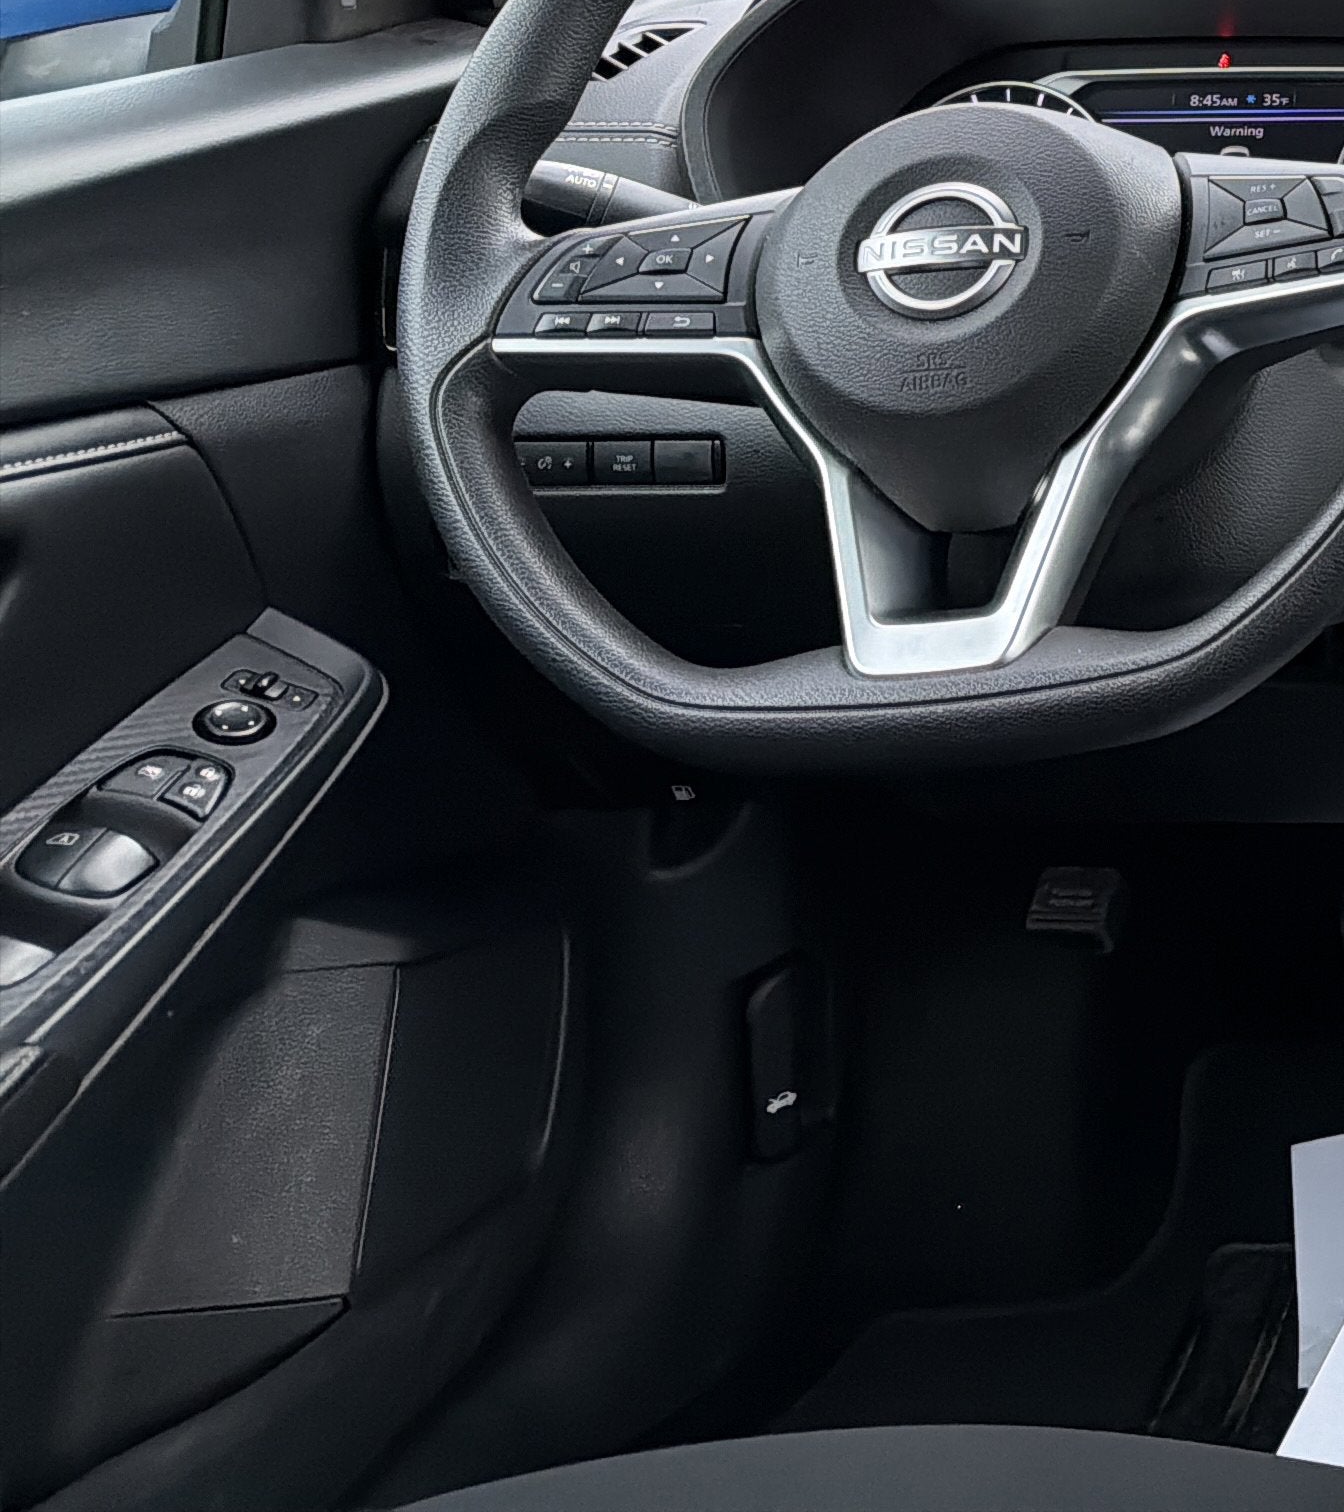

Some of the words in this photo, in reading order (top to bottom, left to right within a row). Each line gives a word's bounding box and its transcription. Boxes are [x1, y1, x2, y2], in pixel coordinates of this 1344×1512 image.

[1210, 125, 1264, 139] Warning
[565, 174, 597, 188] AUTO
[1247, 205, 1279, 216] CANCEL
[1254, 229, 1270, 239] SET
[863, 233, 1022, 264] NISSAN
[655, 254, 674, 265] OK
[900, 374, 968, 393] AIRBAG
[615, 455, 634, 463] TRIP
[612, 463, 637, 472] RESET
